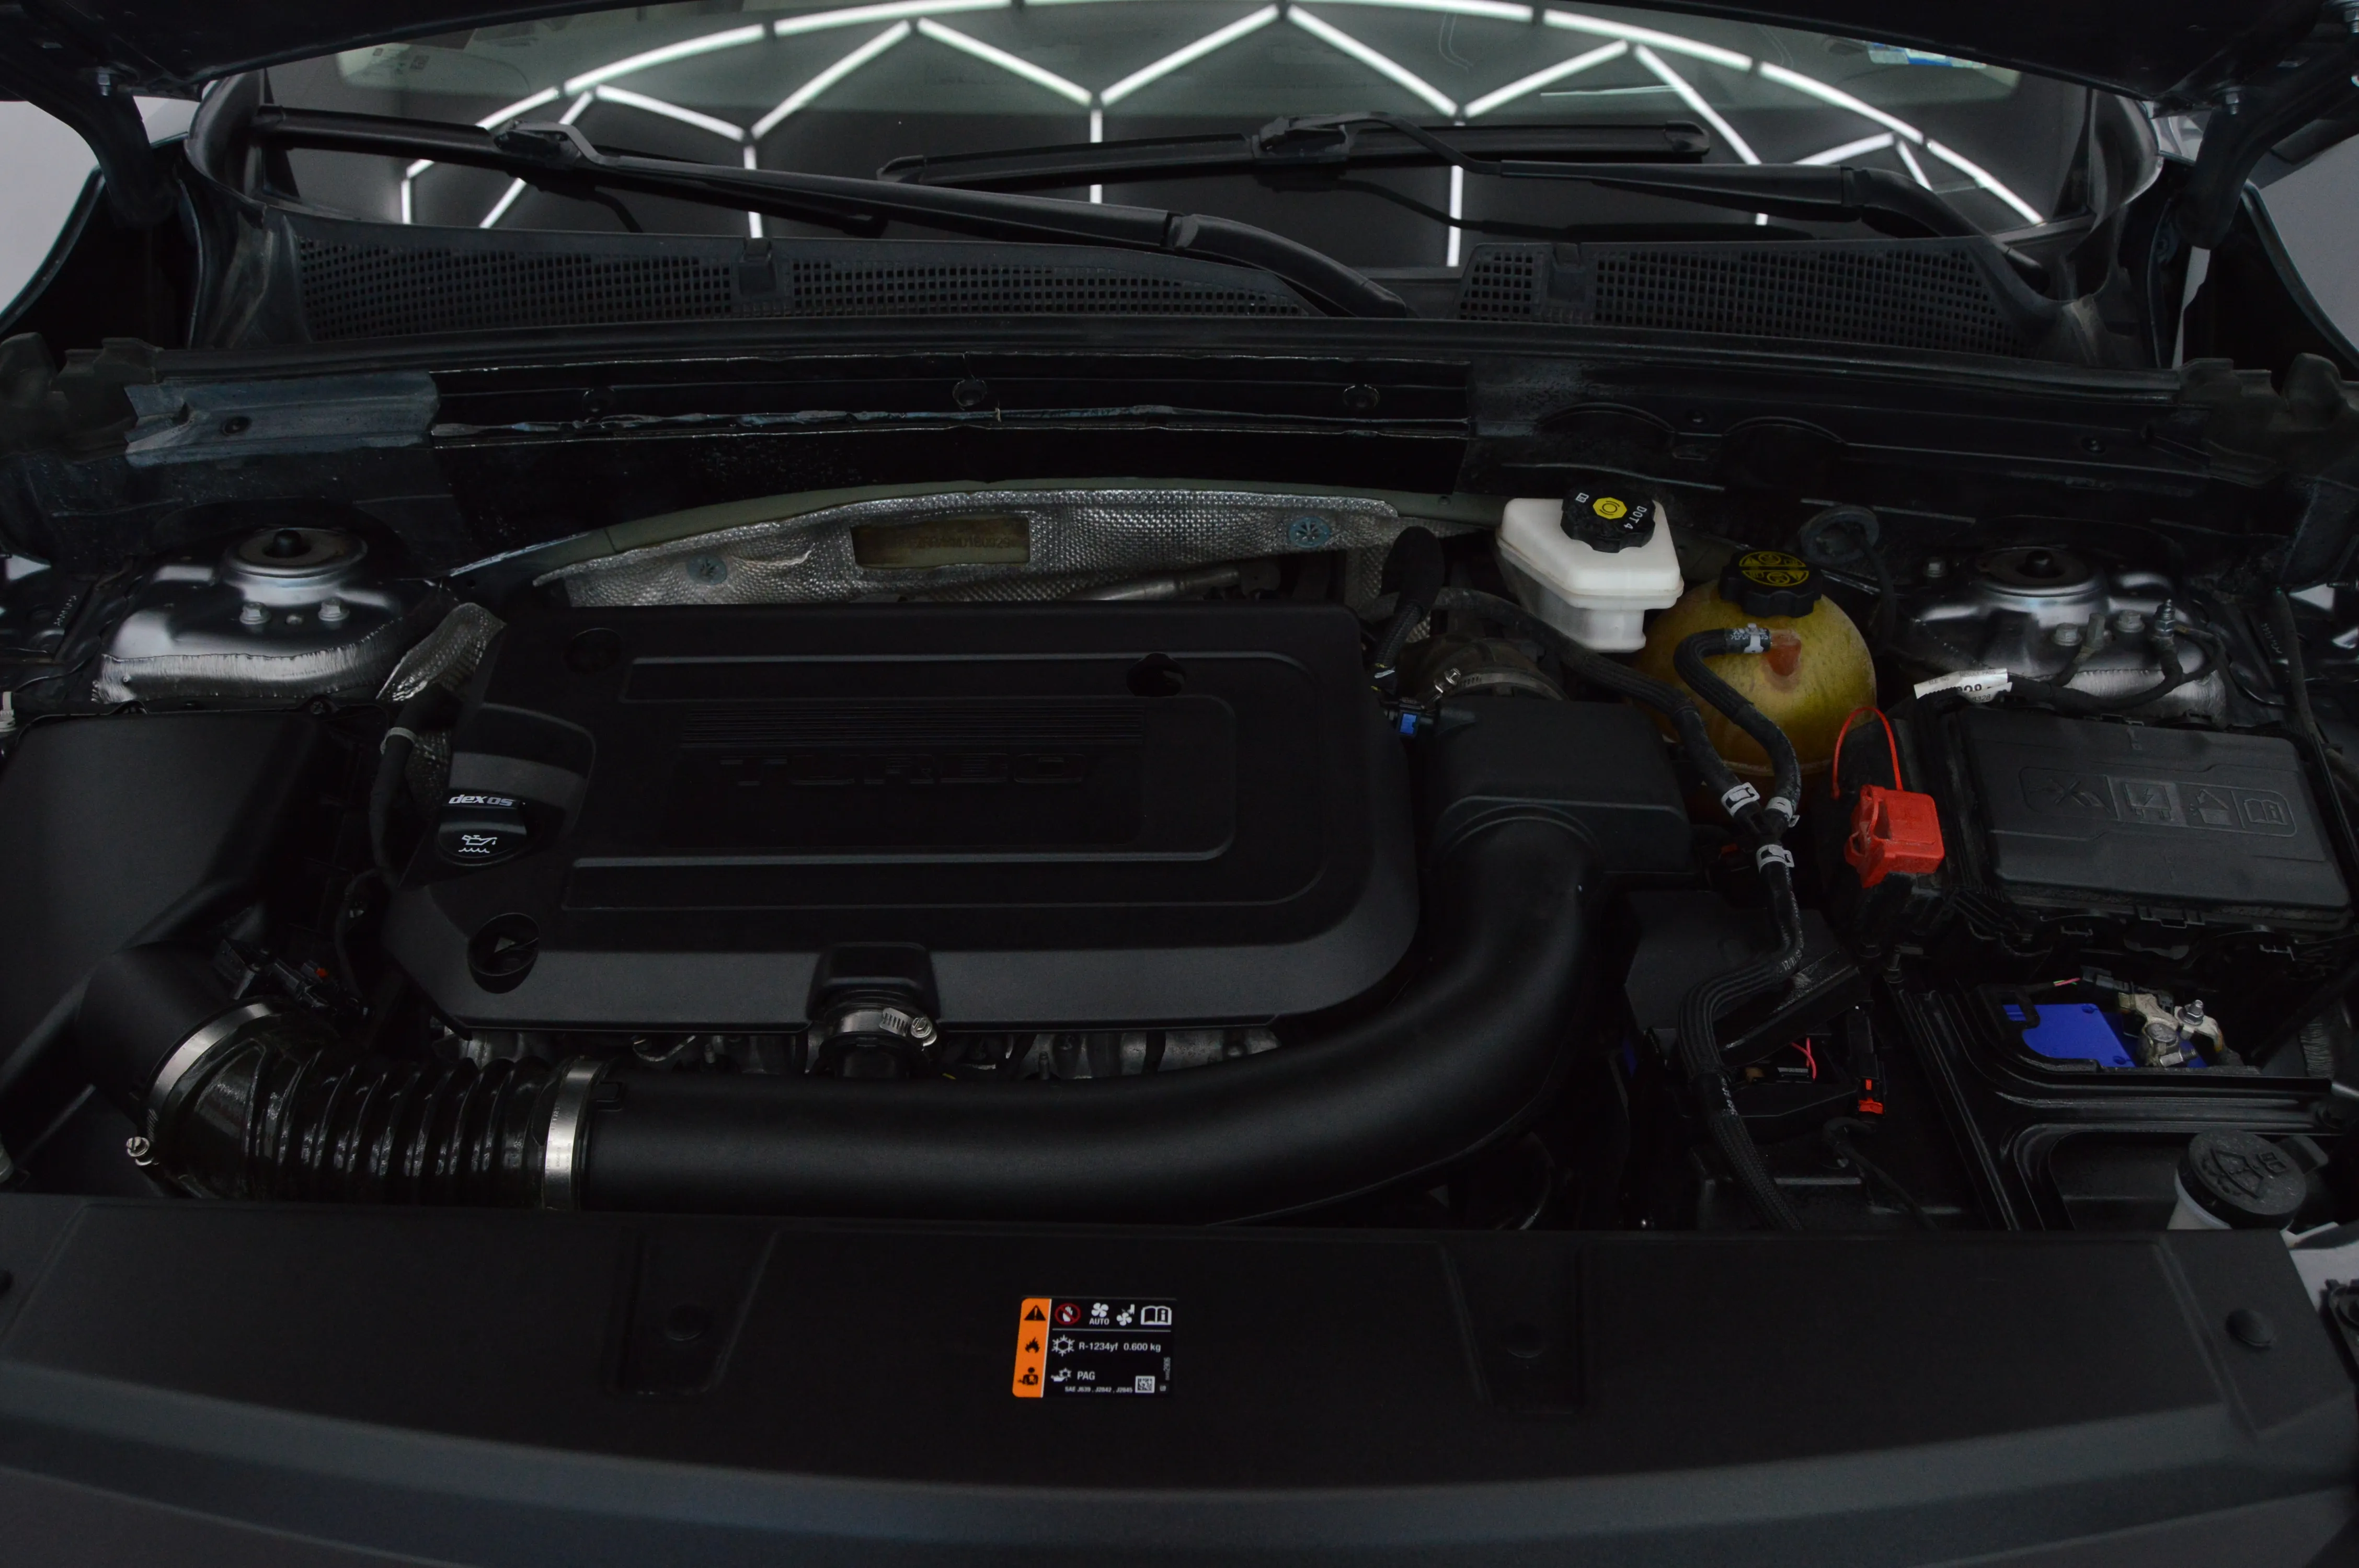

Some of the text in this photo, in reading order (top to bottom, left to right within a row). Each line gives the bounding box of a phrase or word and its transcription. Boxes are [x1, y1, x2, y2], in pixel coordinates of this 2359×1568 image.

[1629, 505, 1647, 524] DOT
[449, 794, 516, 806] dexos
[1079, 1342, 1162, 1353] R-1234yf 0.600 kg
[1077, 1370, 1095, 1380] PAG
